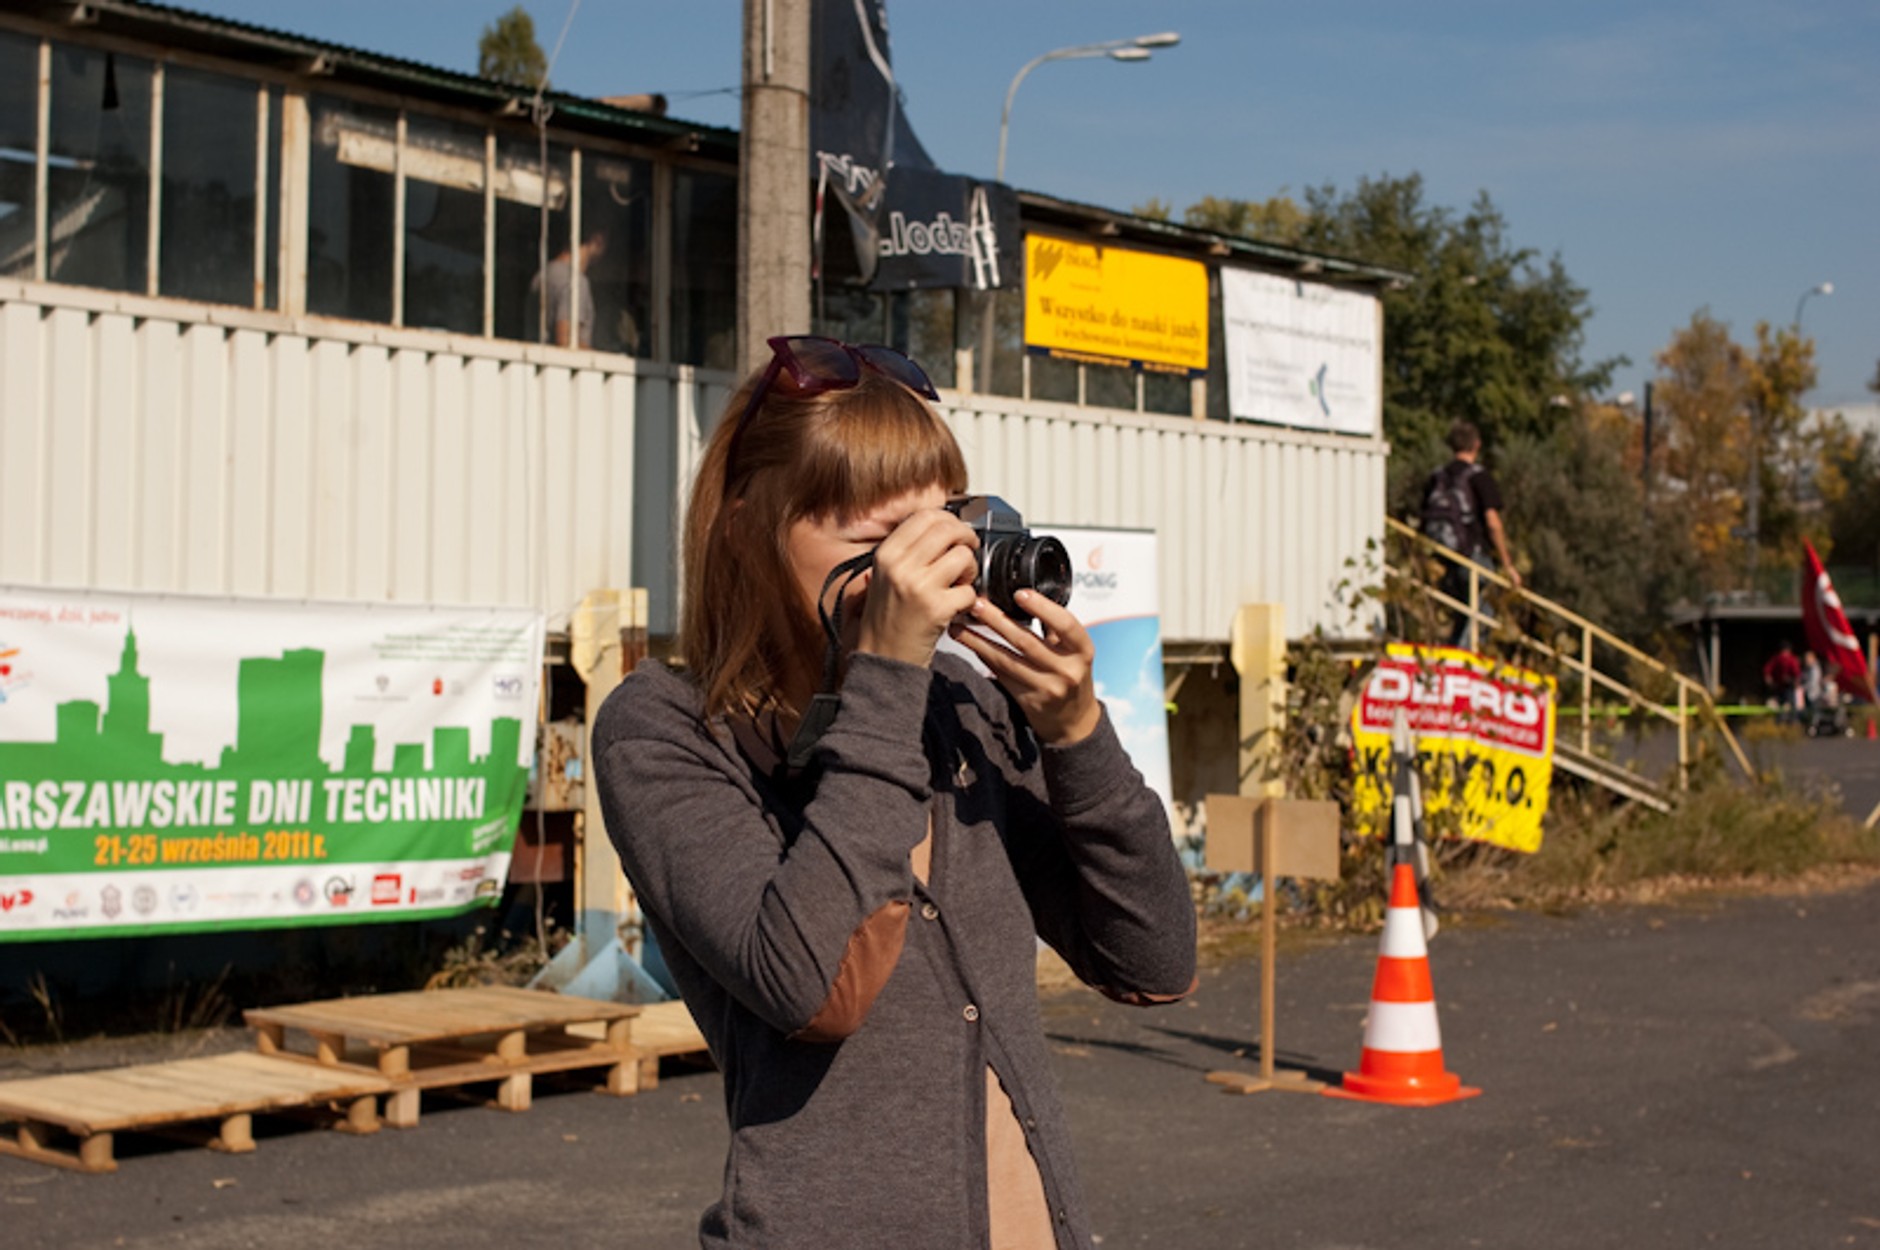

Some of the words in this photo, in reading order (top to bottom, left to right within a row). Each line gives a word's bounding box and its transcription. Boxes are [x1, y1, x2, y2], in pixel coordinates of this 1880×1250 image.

[1039, 296, 1107, 326] Wszystko
[1110, 308, 1128, 328] do
[1131, 313, 1167, 334] nauki
[1367, 668, 1540, 725] DEFRO
[0, 780, 238, 830] RSZAWSKIE
[248, 780, 312, 824] DNI
[323, 777, 486, 823] TECHNIKI
[94, 834, 157, 865] 21-25
[161, 831, 259, 863] września
[263, 831, 310, 860] 2011
[312, 834, 327, 859] r.
